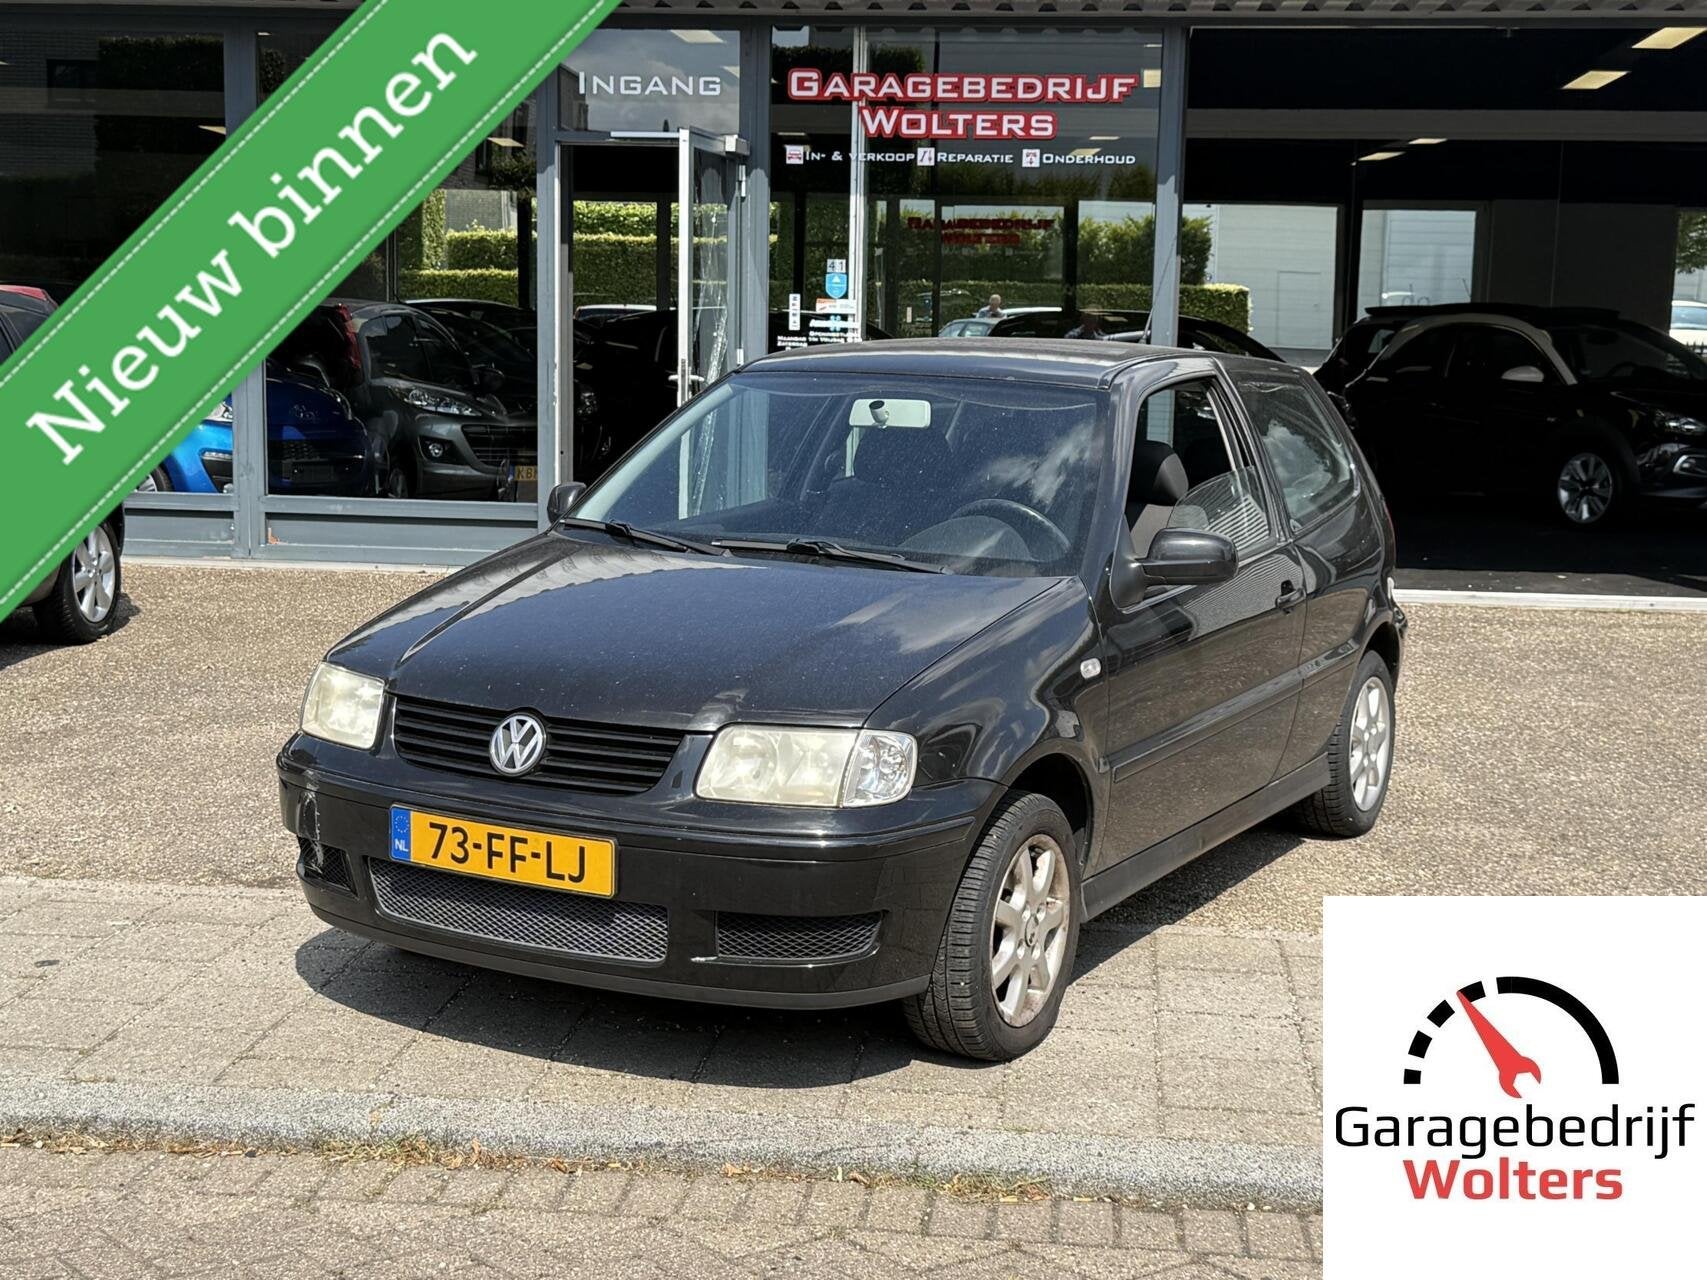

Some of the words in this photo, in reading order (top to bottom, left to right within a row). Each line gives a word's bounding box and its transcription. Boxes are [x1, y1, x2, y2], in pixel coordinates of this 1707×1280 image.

[828, 261, 844, 271] 41
[395, 838, 409, 853] NL
[428, 821, 587, 884] 73-FF-LJ
